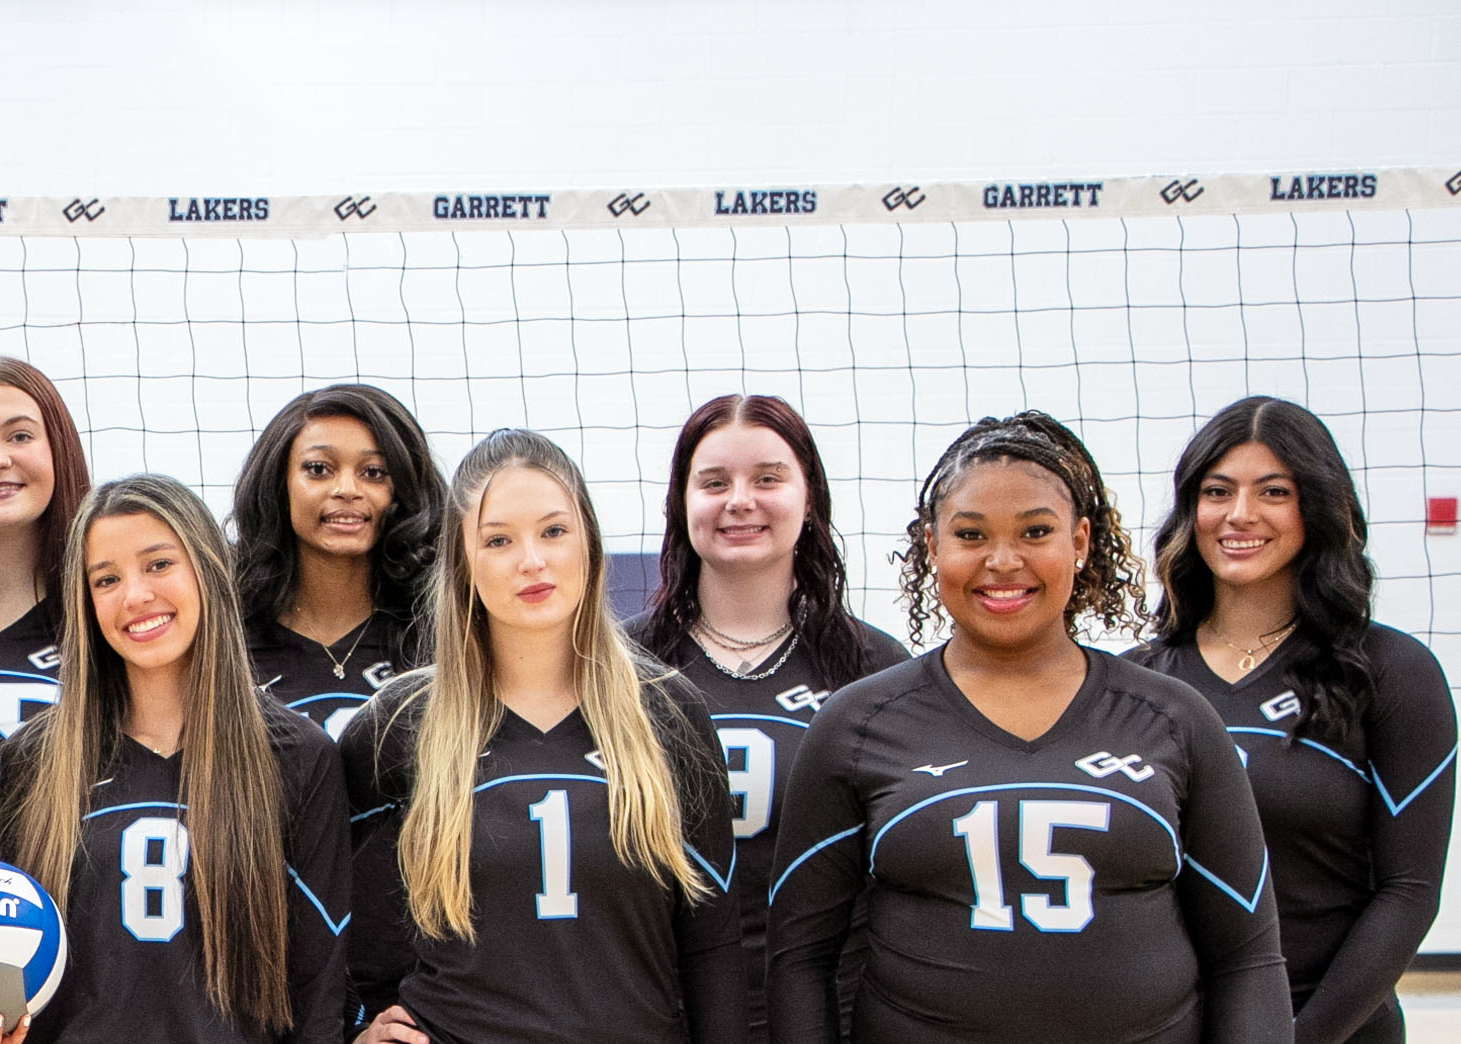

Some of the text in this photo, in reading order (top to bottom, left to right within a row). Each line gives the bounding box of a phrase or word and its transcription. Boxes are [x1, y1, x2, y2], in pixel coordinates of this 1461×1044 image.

[169, 198, 269, 222] LAKERS
[433, 195, 550, 219] GARRETT
[715, 191, 817, 215] LAKERS
[983, 183, 1103, 209] GARRETT
[1270, 174, 1377, 201] LAKERS
[120, 816, 191, 943] 8
[528, 790, 579, 920] 1
[952, 800, 1112, 933] 15
